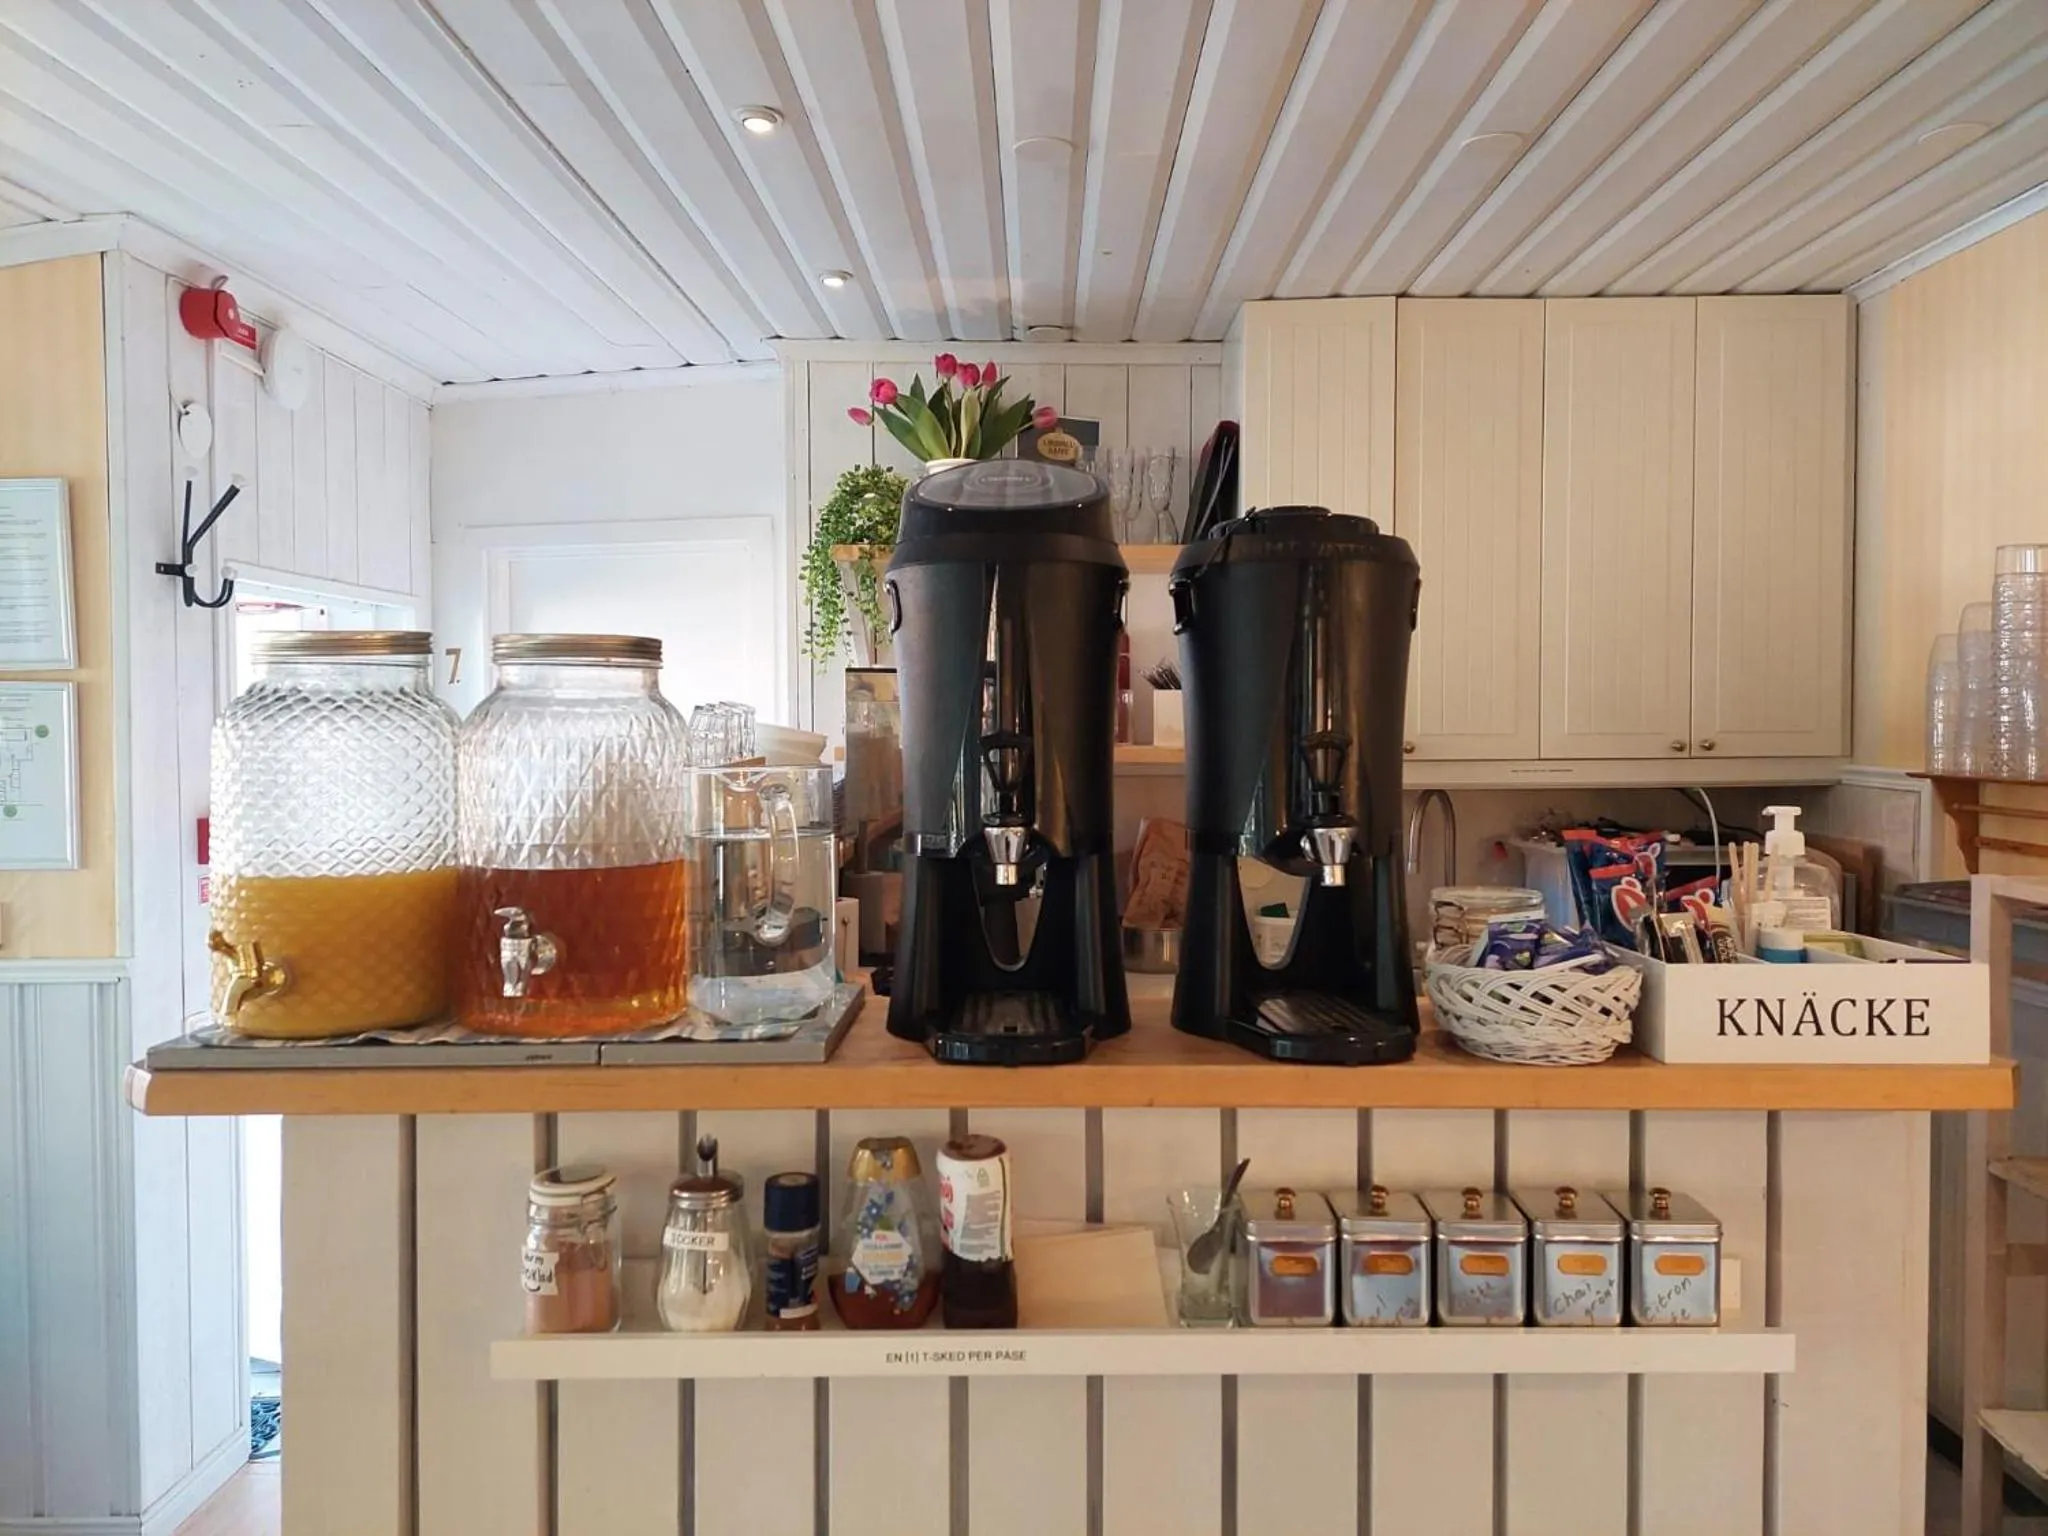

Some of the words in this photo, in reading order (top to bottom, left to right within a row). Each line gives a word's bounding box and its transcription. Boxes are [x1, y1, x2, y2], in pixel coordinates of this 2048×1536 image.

[1716, 992, 1932, 1037] KNÄCKE
[885, 1352, 903, 1364] EN
[922, 1351, 966, 1362] T-SKED
[969, 1350, 992, 1362] PER
